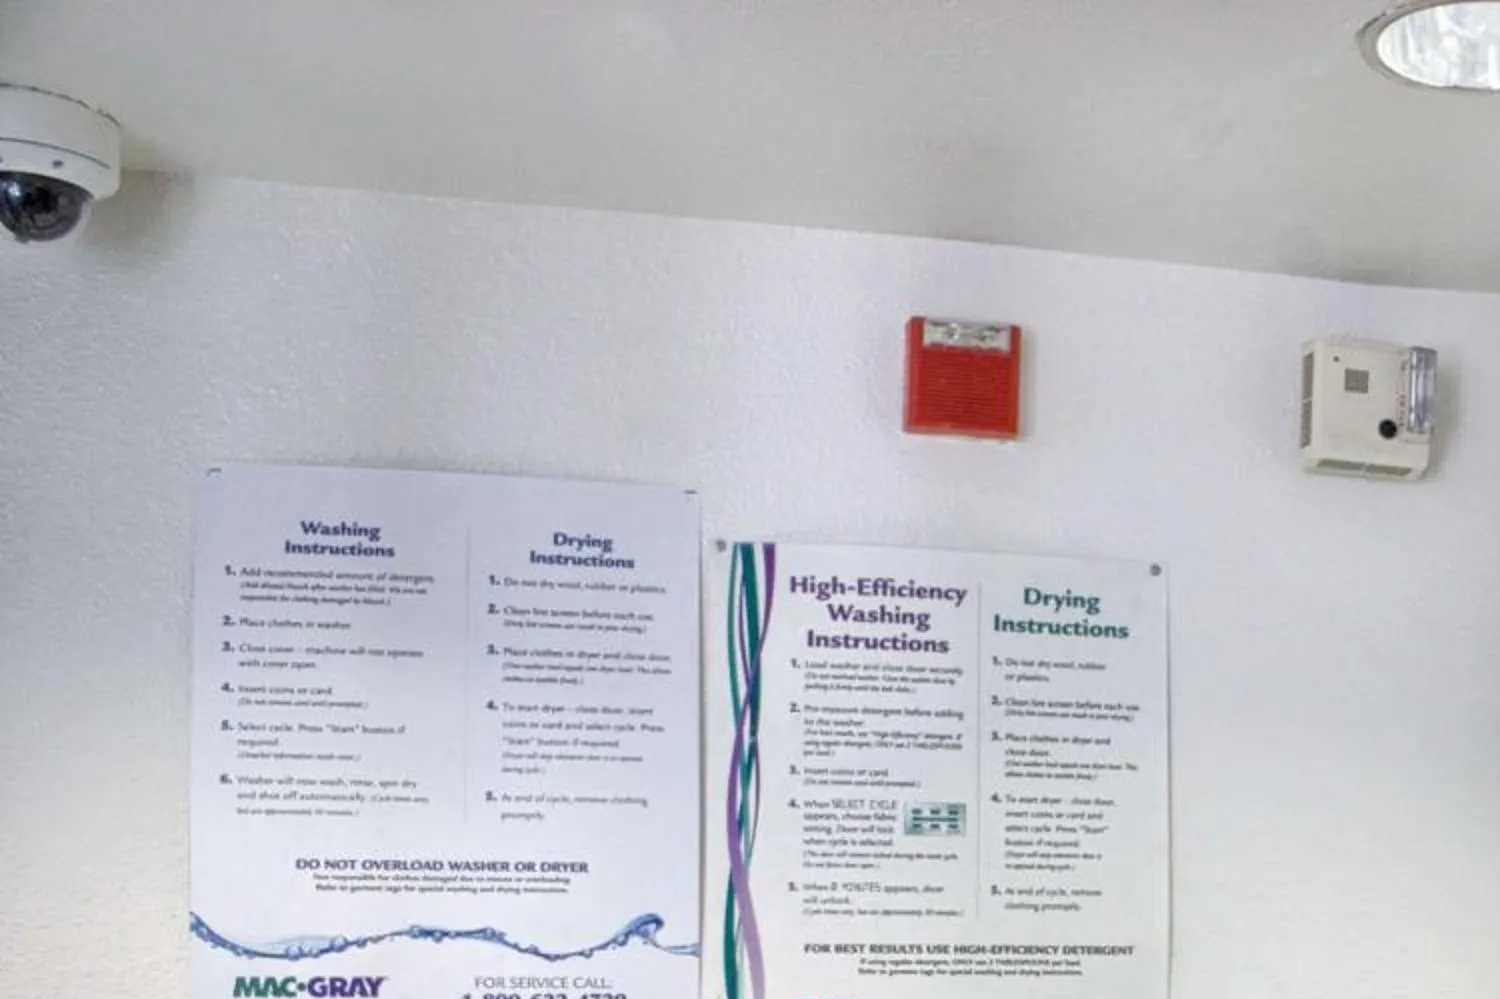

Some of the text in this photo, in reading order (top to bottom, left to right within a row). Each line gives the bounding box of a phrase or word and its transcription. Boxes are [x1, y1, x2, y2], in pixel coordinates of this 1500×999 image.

[300, 521, 380, 541] Washing
[285, 541, 394, 557] Instructions
[553, 533, 612, 552] Drying
[529, 552, 634, 568] Instructions
[239, 567, 261, 576] Add
[790, 576, 967, 605] High-Efficiency
[1023, 588, 1100, 614] Drying
[827, 604, 929, 629] Washing
[994, 616, 1128, 638] Instructions
[807, 631, 949, 653] Instructions
[295, 858, 588, 872] DO NOT OVERLOAD WASHER OR DRYER
[803, 943, 1133, 955] FOR BEST RESULTS USE HIGH-EFFICIENCY DETERGENT
[474, 976, 506, 988] FOR
[509, 976, 568, 988] SERVICE
